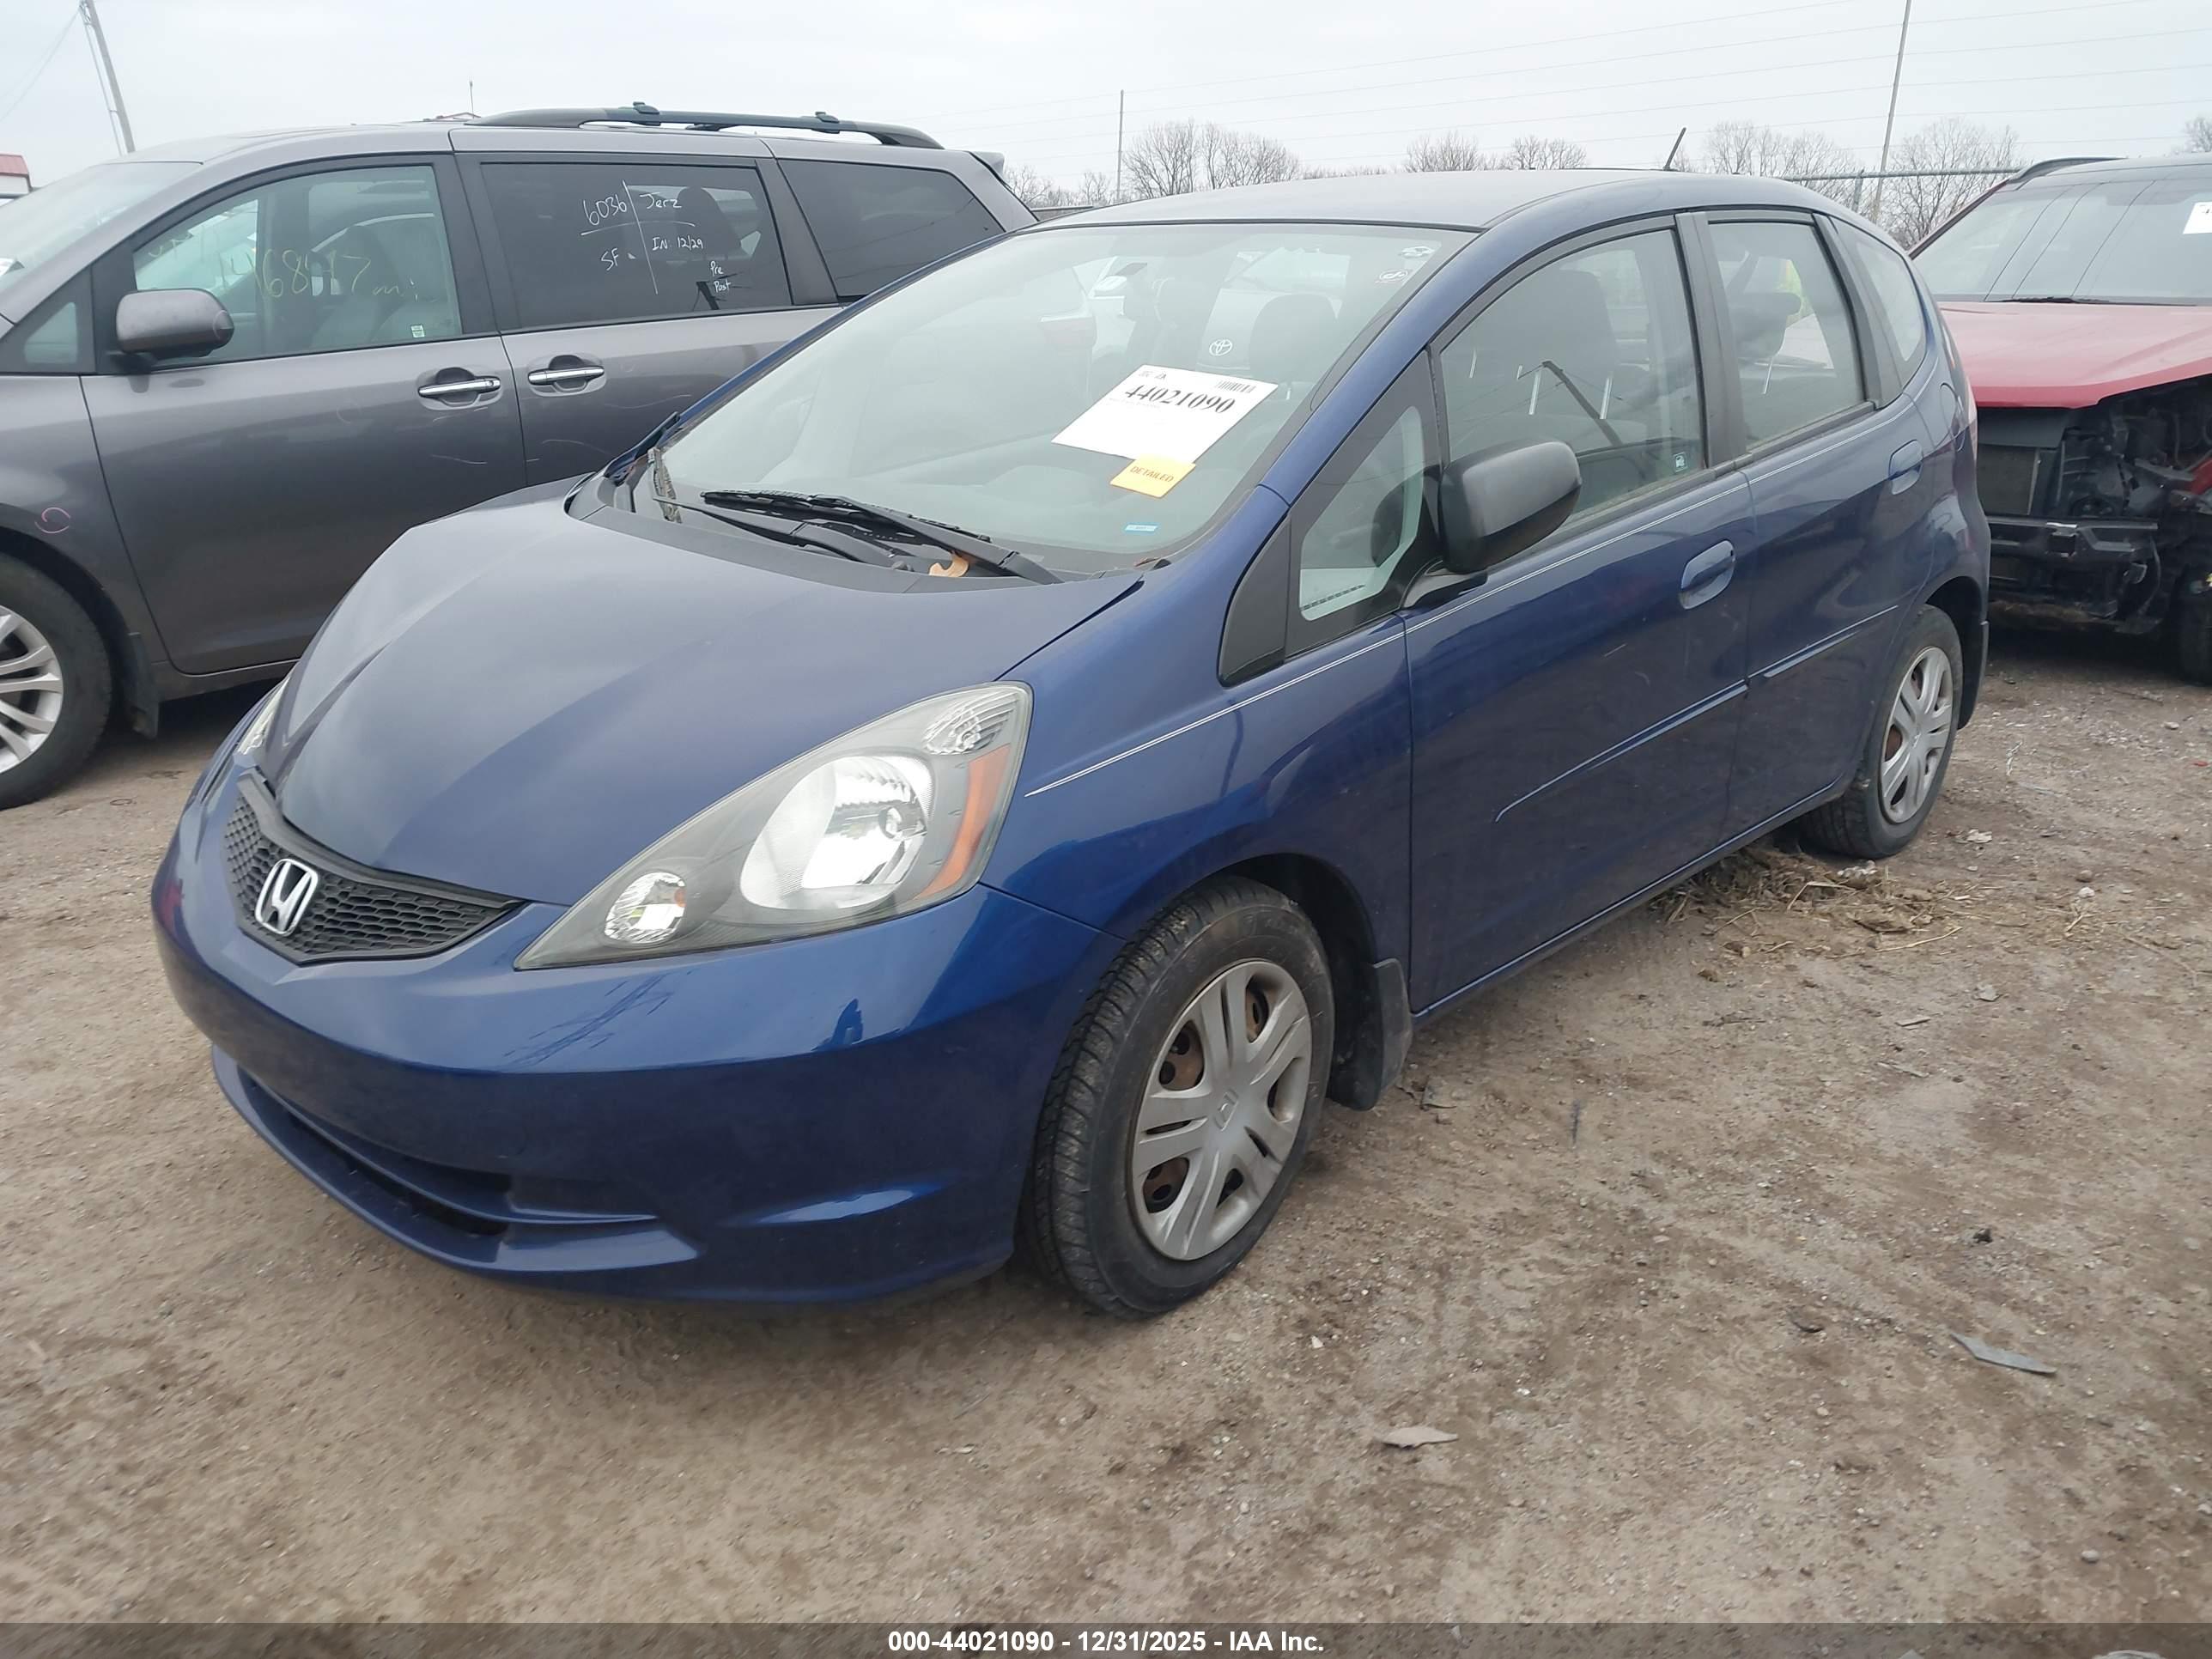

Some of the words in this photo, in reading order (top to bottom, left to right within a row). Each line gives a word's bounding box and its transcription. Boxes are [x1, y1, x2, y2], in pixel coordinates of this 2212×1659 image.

[677, 234, 704, 253] 12/29
[1125, 385, 1236, 414] 44021090
[1129, 465, 1175, 483] DETAILED
